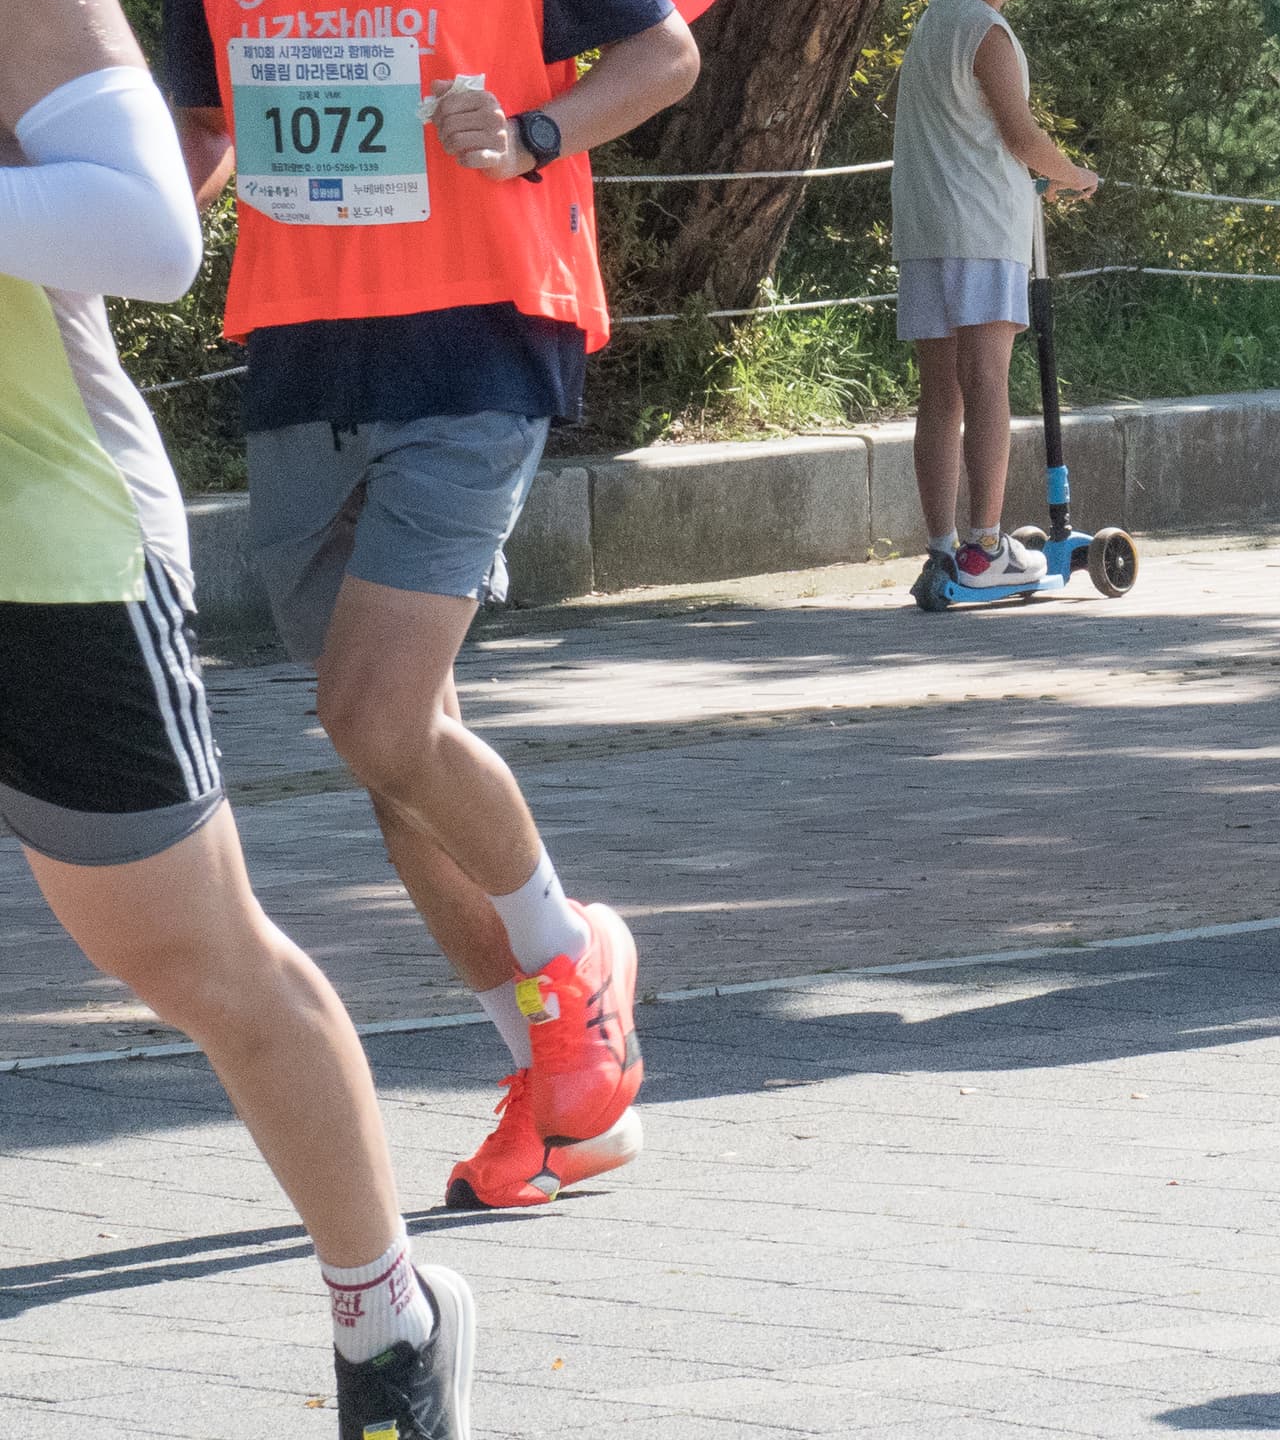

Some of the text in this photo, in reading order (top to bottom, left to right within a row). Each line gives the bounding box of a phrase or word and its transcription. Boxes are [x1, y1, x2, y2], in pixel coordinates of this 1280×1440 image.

[243, 45, 395, 59] 제10회 시각장애인과 함께하는
[251, 63, 368, 81] 어울림 마라톤대회
[265, 106, 387, 154] 1072
